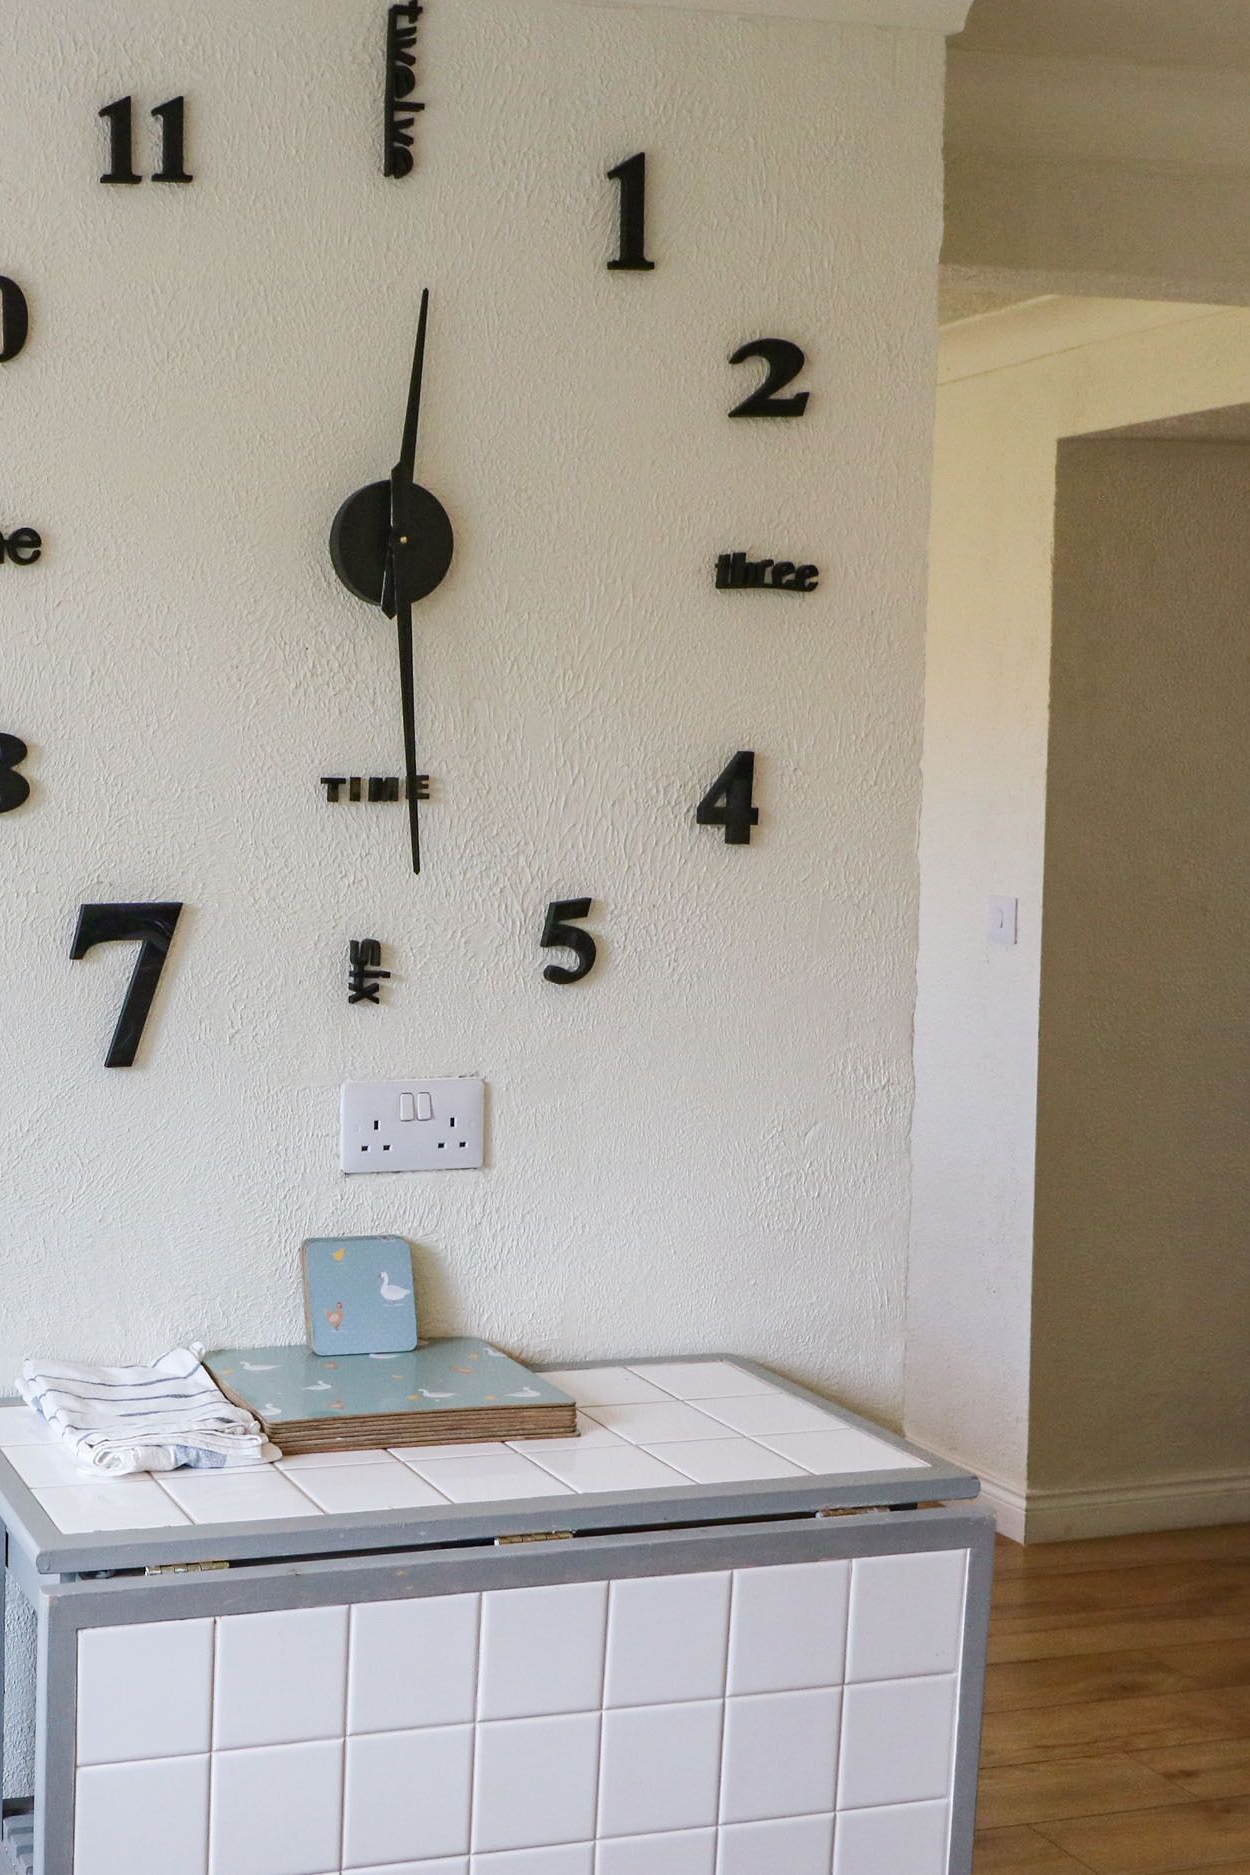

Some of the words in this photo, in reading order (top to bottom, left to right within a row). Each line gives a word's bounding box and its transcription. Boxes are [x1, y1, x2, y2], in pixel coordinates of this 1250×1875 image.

[384, 0, 426, 180] twelve
[97, 94, 195, 185] 11
[605, 151, 657, 271] 1
[726, 337, 812, 420] 2
[714, 551, 820, 594] three
[320, 775, 431, 803] TIME
[696, 750, 761, 847] 4
[348, 938, 391, 1005] six
[539, 896, 598, 985] 5
[69, 902, 185, 1070] 7
